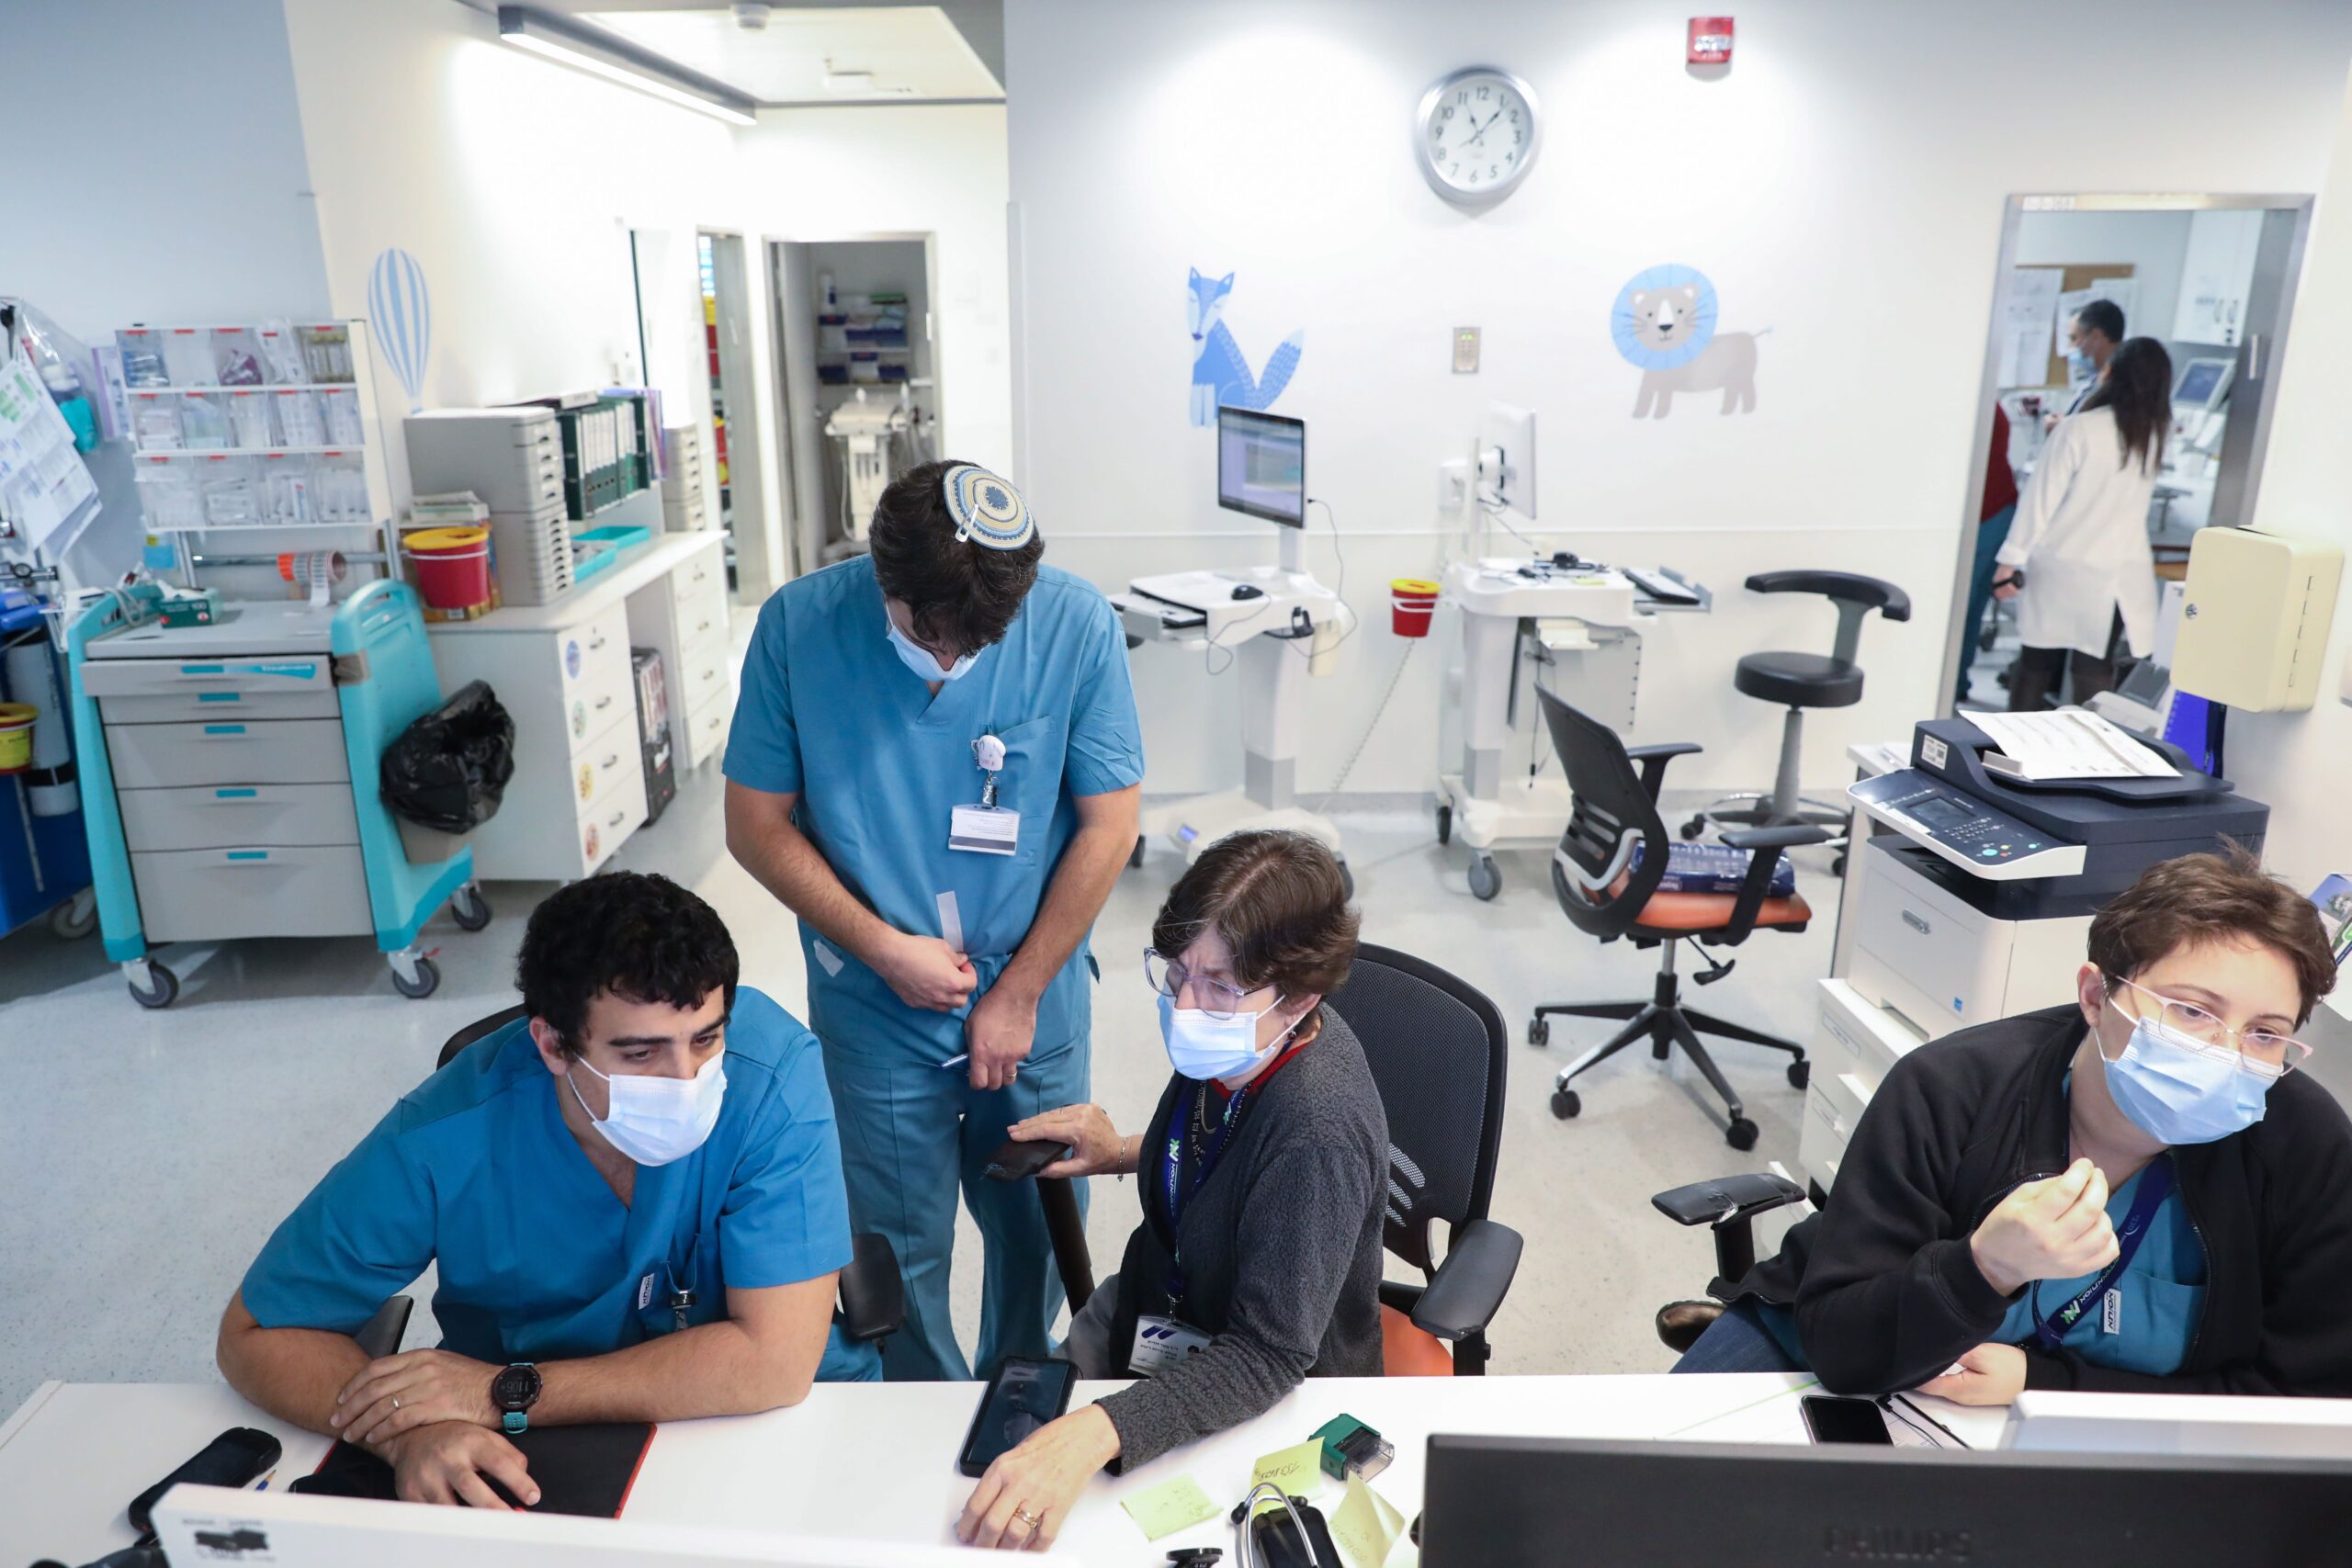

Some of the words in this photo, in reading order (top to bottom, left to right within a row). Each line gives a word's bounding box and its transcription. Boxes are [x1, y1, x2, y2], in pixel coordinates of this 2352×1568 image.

[1458, 91, 1468, 105] 11
[1476, 86, 1489, 100] 12
[1441, 106, 1454, 119] 10
[1510, 109, 1519, 123] 2
[1435, 127, 1443, 140] 9
[1514, 130, 1521, 144] 3
[1438, 147, 1446, 160] 8
[1505, 152, 1513, 163] 4
[1451, 163, 1459, 176] 7
[1469, 169, 1477, 183] 6
[1489, 165, 1498, 178] 5
[1824, 1528, 1973, 1562] PHILIPS
